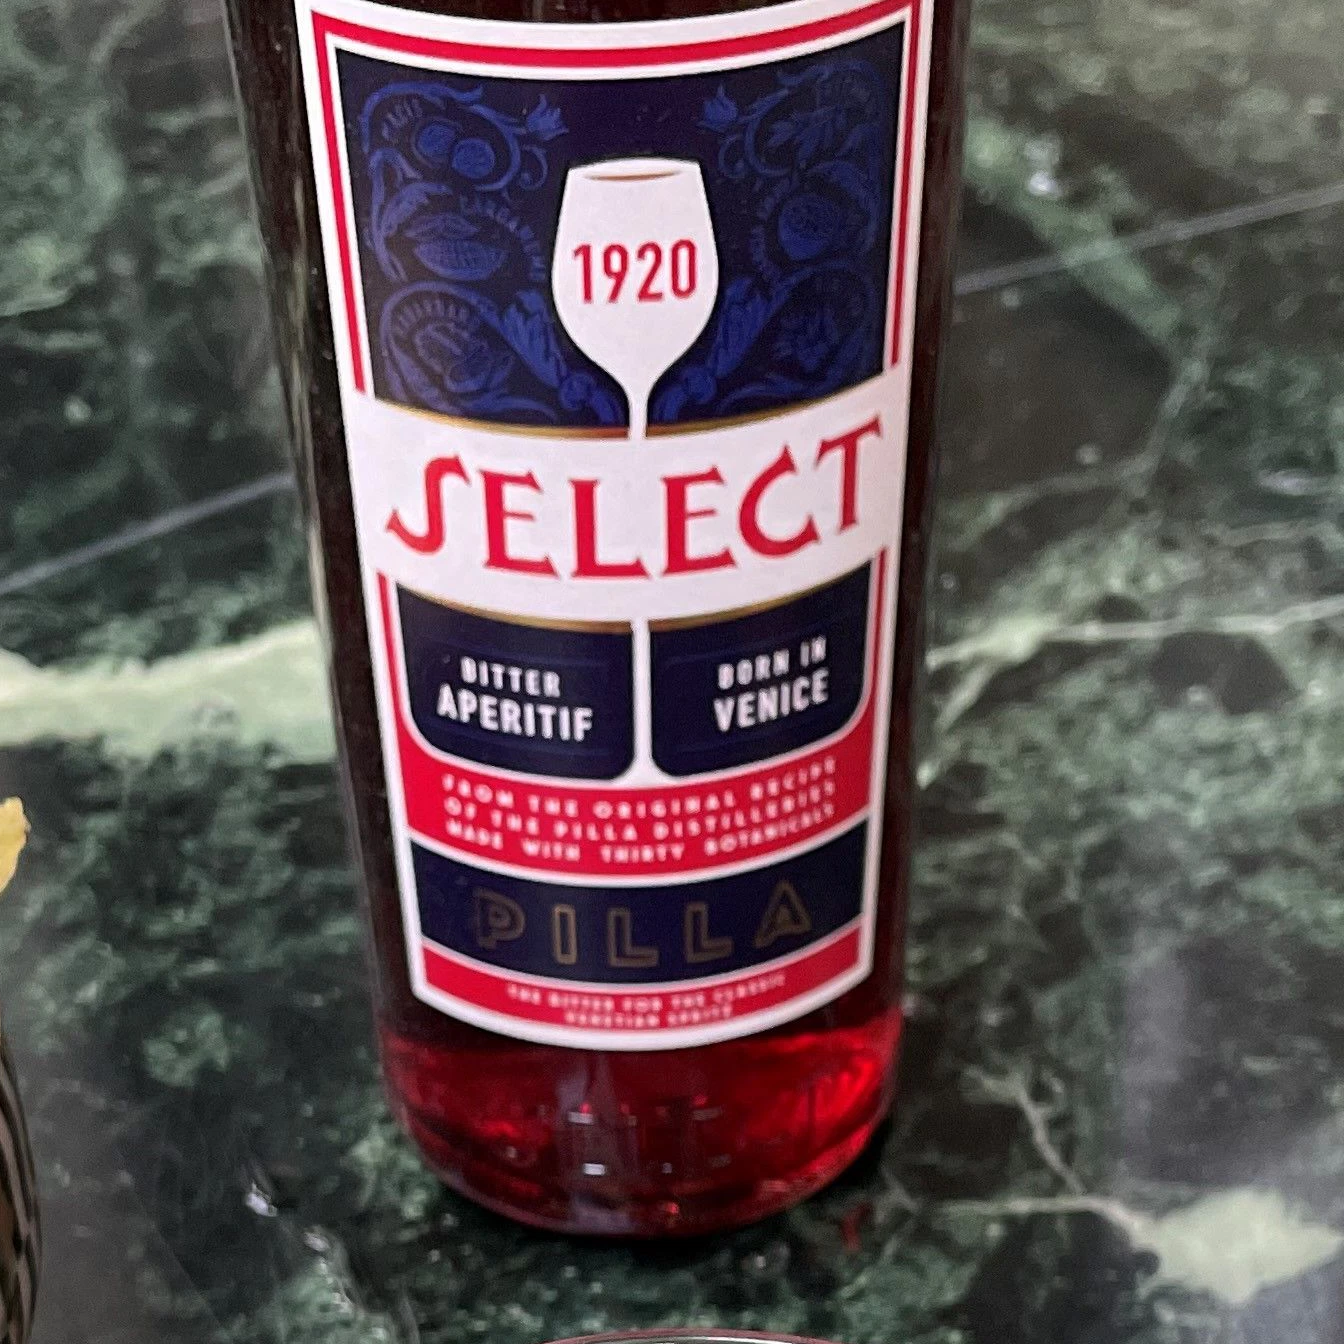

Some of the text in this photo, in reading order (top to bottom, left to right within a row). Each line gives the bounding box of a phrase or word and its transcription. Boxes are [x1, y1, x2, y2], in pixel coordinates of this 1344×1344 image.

[572, 238, 698, 305] 1920
[385, 416, 883, 580] SELECT
[459, 655, 561, 699] BITTER
[717, 634, 827, 691] BORN IN
[436, 683, 594, 743] APERITIF
[713, 668, 829, 734] VENICE
[442, 755, 836, 820] FROM THE ORIGINAL RECIPE
[444, 796, 477, 820] OF
[491, 809, 540, 836] THE
[554, 819, 638, 841] PILLA
[445, 817, 503, 850] MADE
[521, 837, 581, 862] WITH
[600, 844, 684, 863] THIRTY
[471, 879, 813, 968] PILLA
